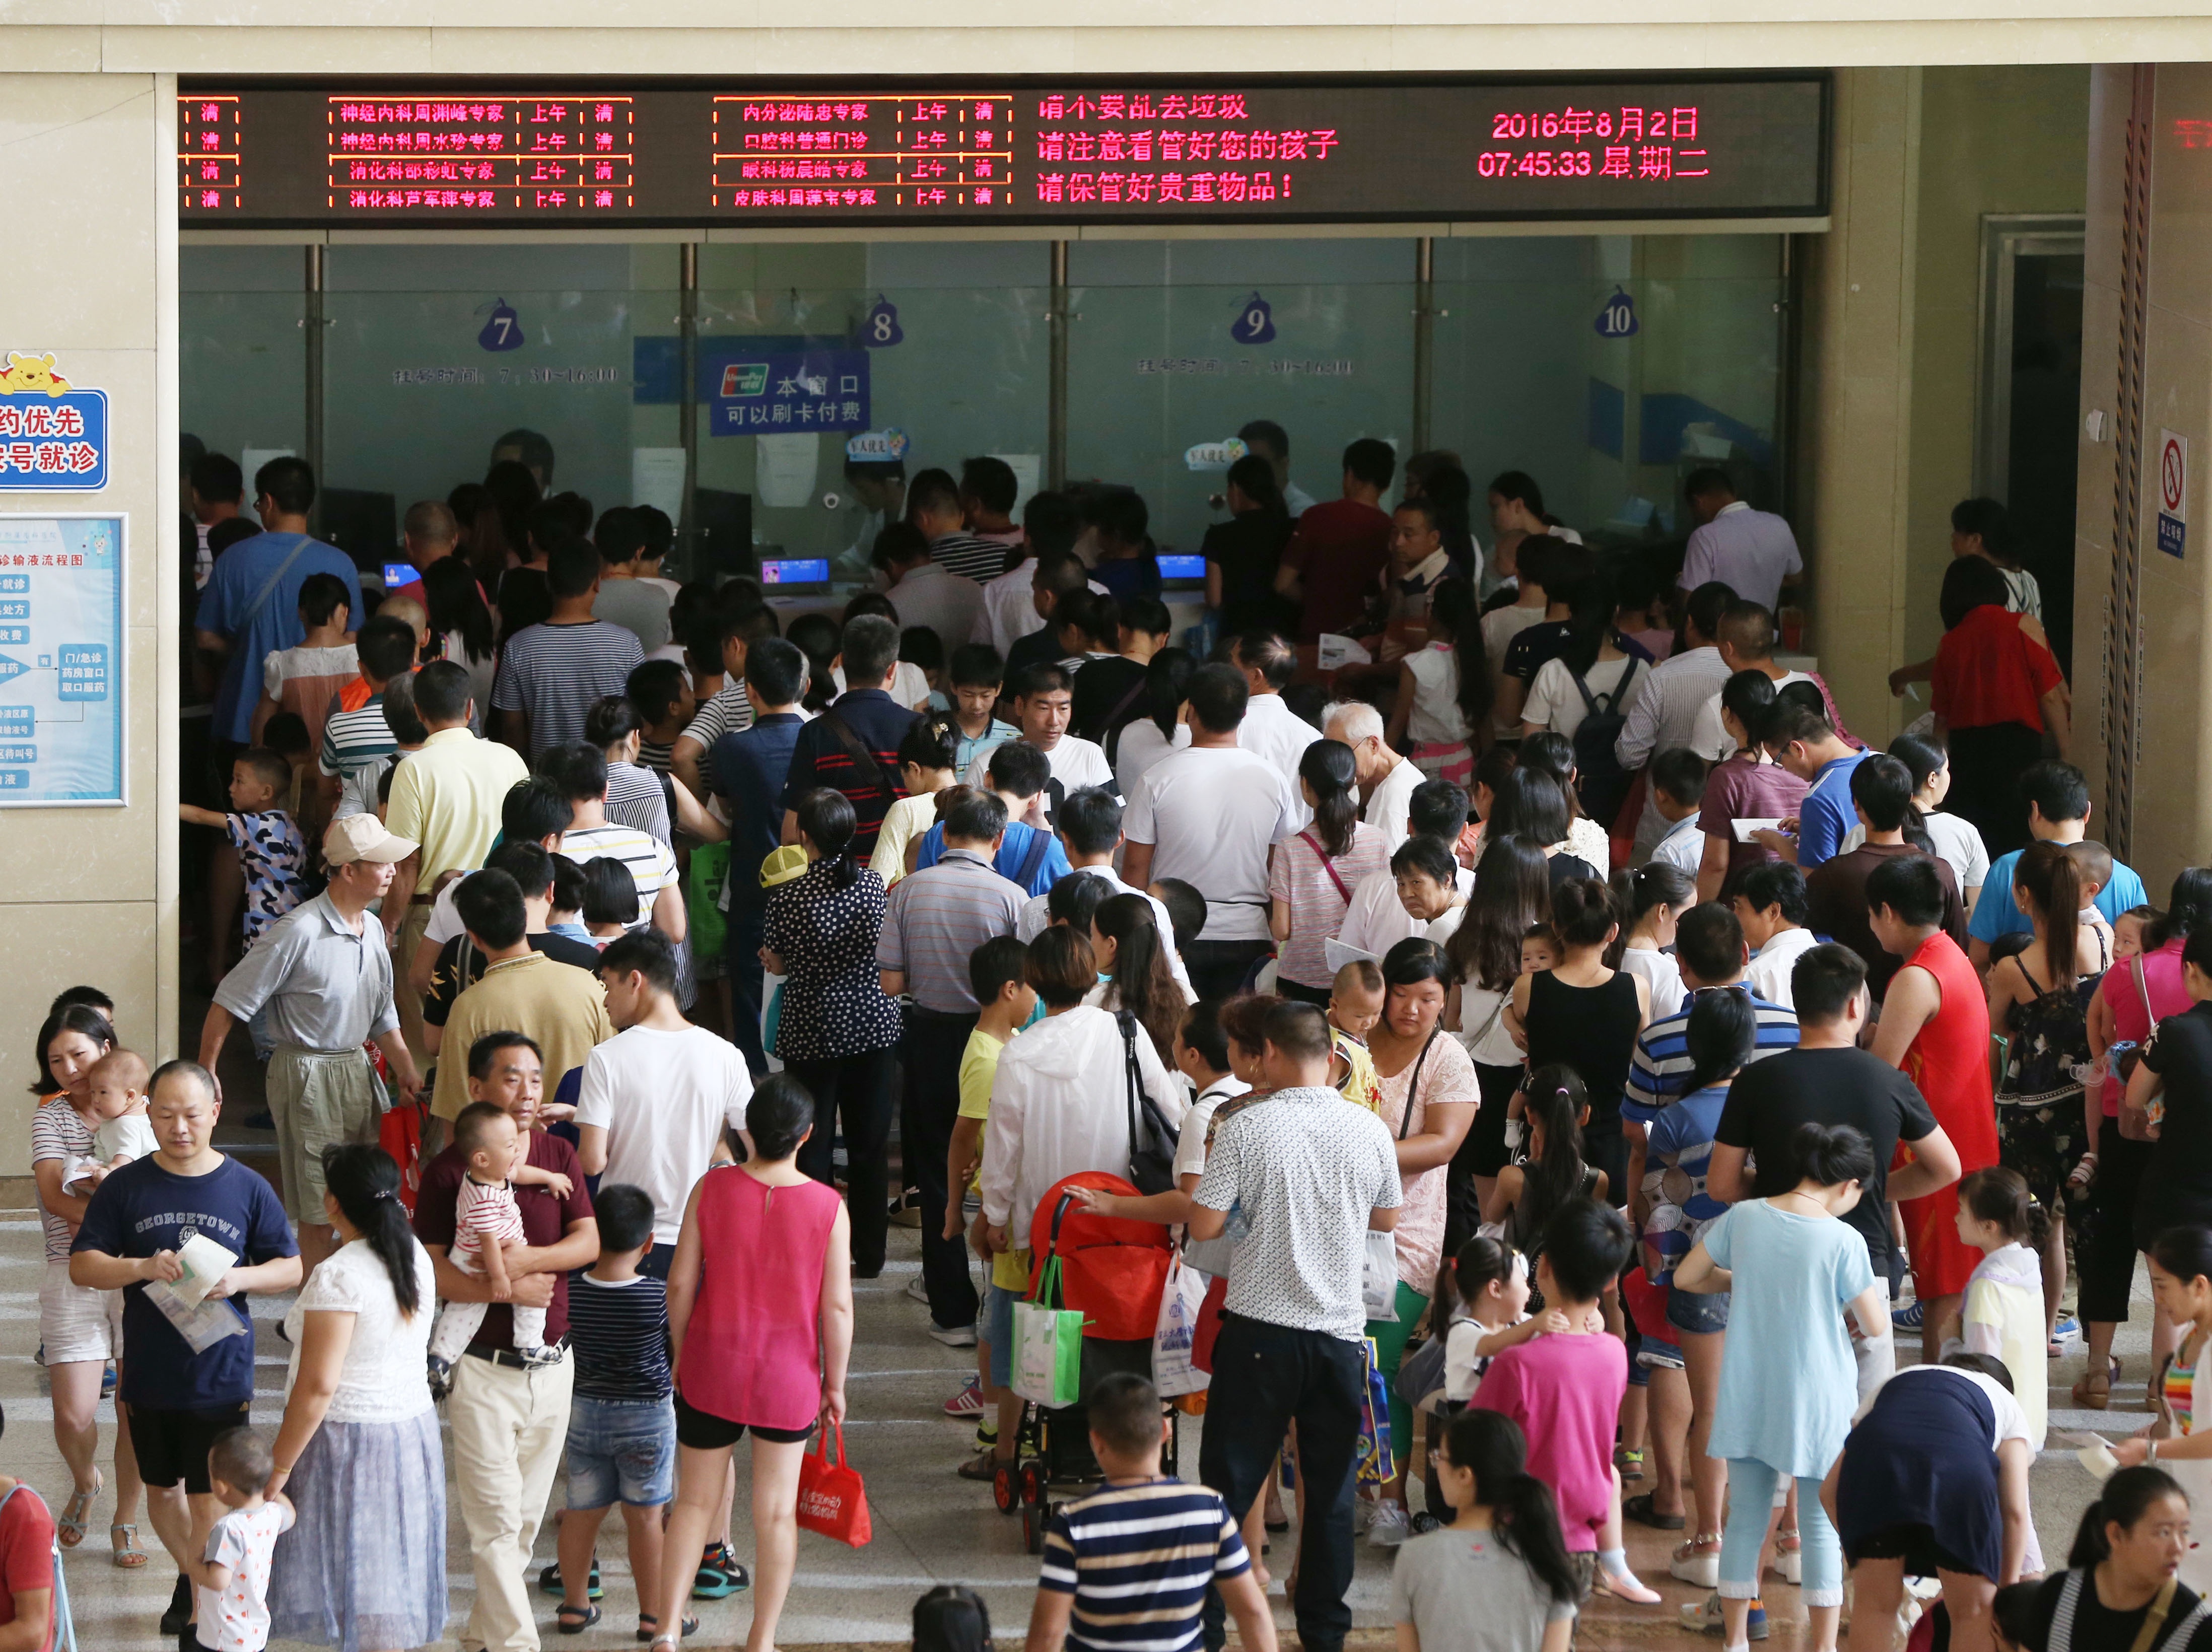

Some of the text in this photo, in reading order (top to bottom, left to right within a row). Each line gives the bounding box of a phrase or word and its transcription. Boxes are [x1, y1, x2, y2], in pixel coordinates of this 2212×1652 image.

[201, 103, 218, 121] 满
[531, 104, 566, 122] 上午
[595, 104, 613, 121] 满
[912, 103, 947, 120] 上午
[975, 102, 993, 120] 满
[1492, 107, 1698, 143] 2016年8月2日
[201, 132, 219, 151] 满
[531, 133, 566, 151] 上午
[595, 132, 612, 151] 满
[744, 130, 993, 150] 口腔科普通门诊 上午 满
[1037, 129, 1339, 162] 请注意看管好您的孩子
[201, 161, 219, 179] 满
[530, 162, 566, 180] 上午
[595, 161, 612, 179] 满
[911, 160, 946, 177] 上午
[975, 159, 992, 177] 满
[1478, 146, 1710, 181] 07:45:33 星期二
[202, 190, 219, 208] 满
[530, 190, 566, 208] 上午
[595, 190, 612, 207] 满
[911, 188, 946, 205] 上午
[974, 187, 992, 204] 满
[873, 313, 892, 341] 8
[1248, 309, 1265, 336] 9
[1605, 305, 1631, 333] 10
[494, 318, 512, 345] 7
[777, 376, 858, 398] 本窗口
[0, 408, 81, 434] 约优先
[726, 401, 861, 425] 可以刷卡付费
[0, 579, 25, 590] 就诊
[0, 604, 25, 615] 处方
[40, 657, 49, 666] 有
[65, 653, 102, 663] 门/急诊
[62, 667, 104, 678] 药房窗口
[62, 682, 105, 693] 取口服药
[135, 1212, 240, 1241] GEORGETOWN
